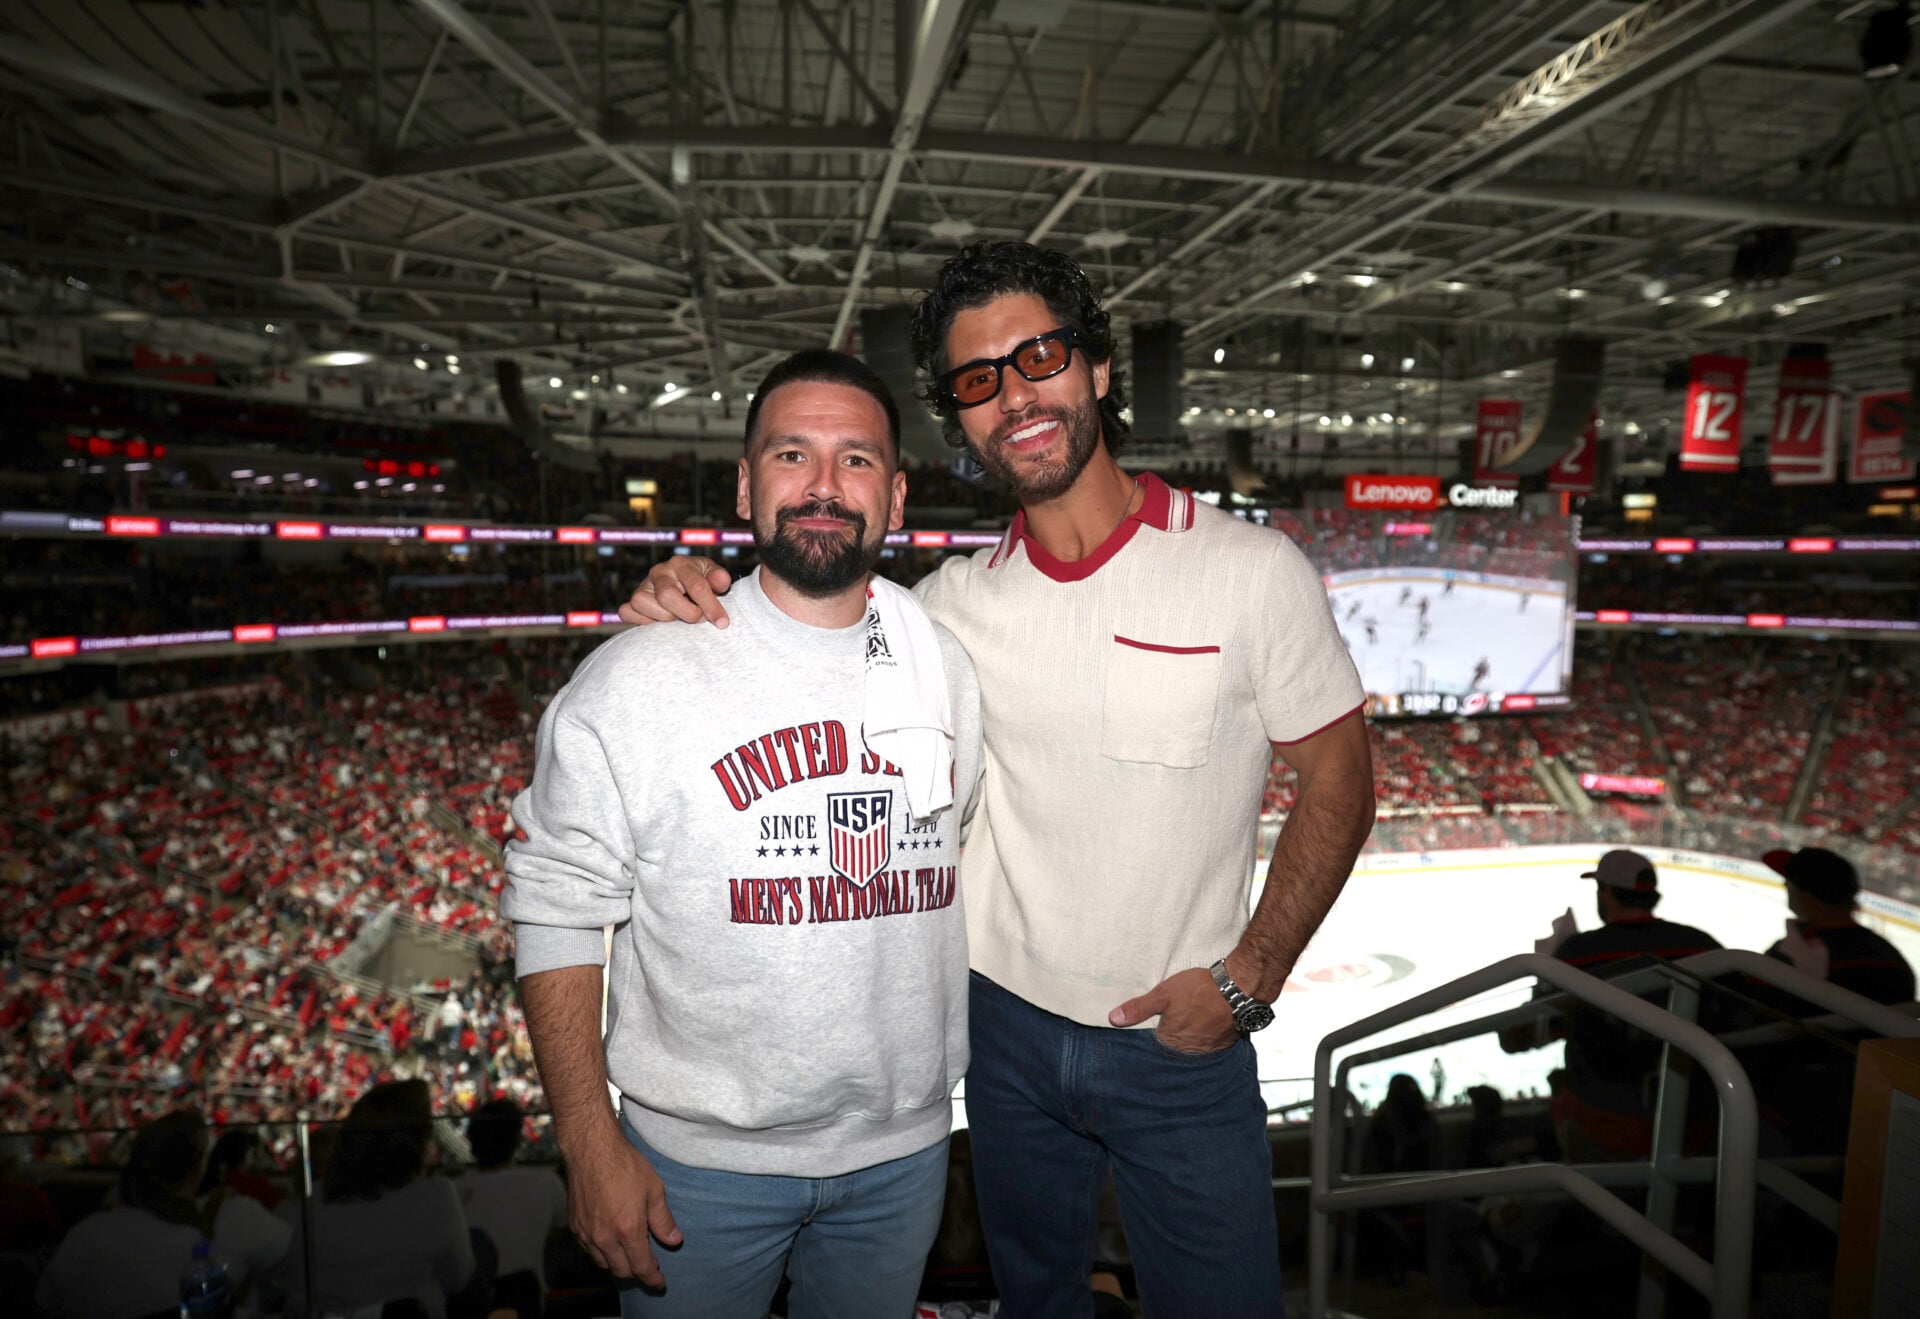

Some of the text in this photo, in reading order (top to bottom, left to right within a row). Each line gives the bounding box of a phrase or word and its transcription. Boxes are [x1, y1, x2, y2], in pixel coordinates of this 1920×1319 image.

[1692, 391, 1737, 441] 12
[1777, 394, 1825, 442] 17
[1560, 436, 1587, 473] 2
[1353, 481, 1518, 507] Lenovo Center
[711, 720, 848, 811] UNITED
[760, 815, 817, 840] SINCE
[833, 796, 887, 833] USA
[729, 866, 957, 924] MEN'S NATIONAL TEAM
